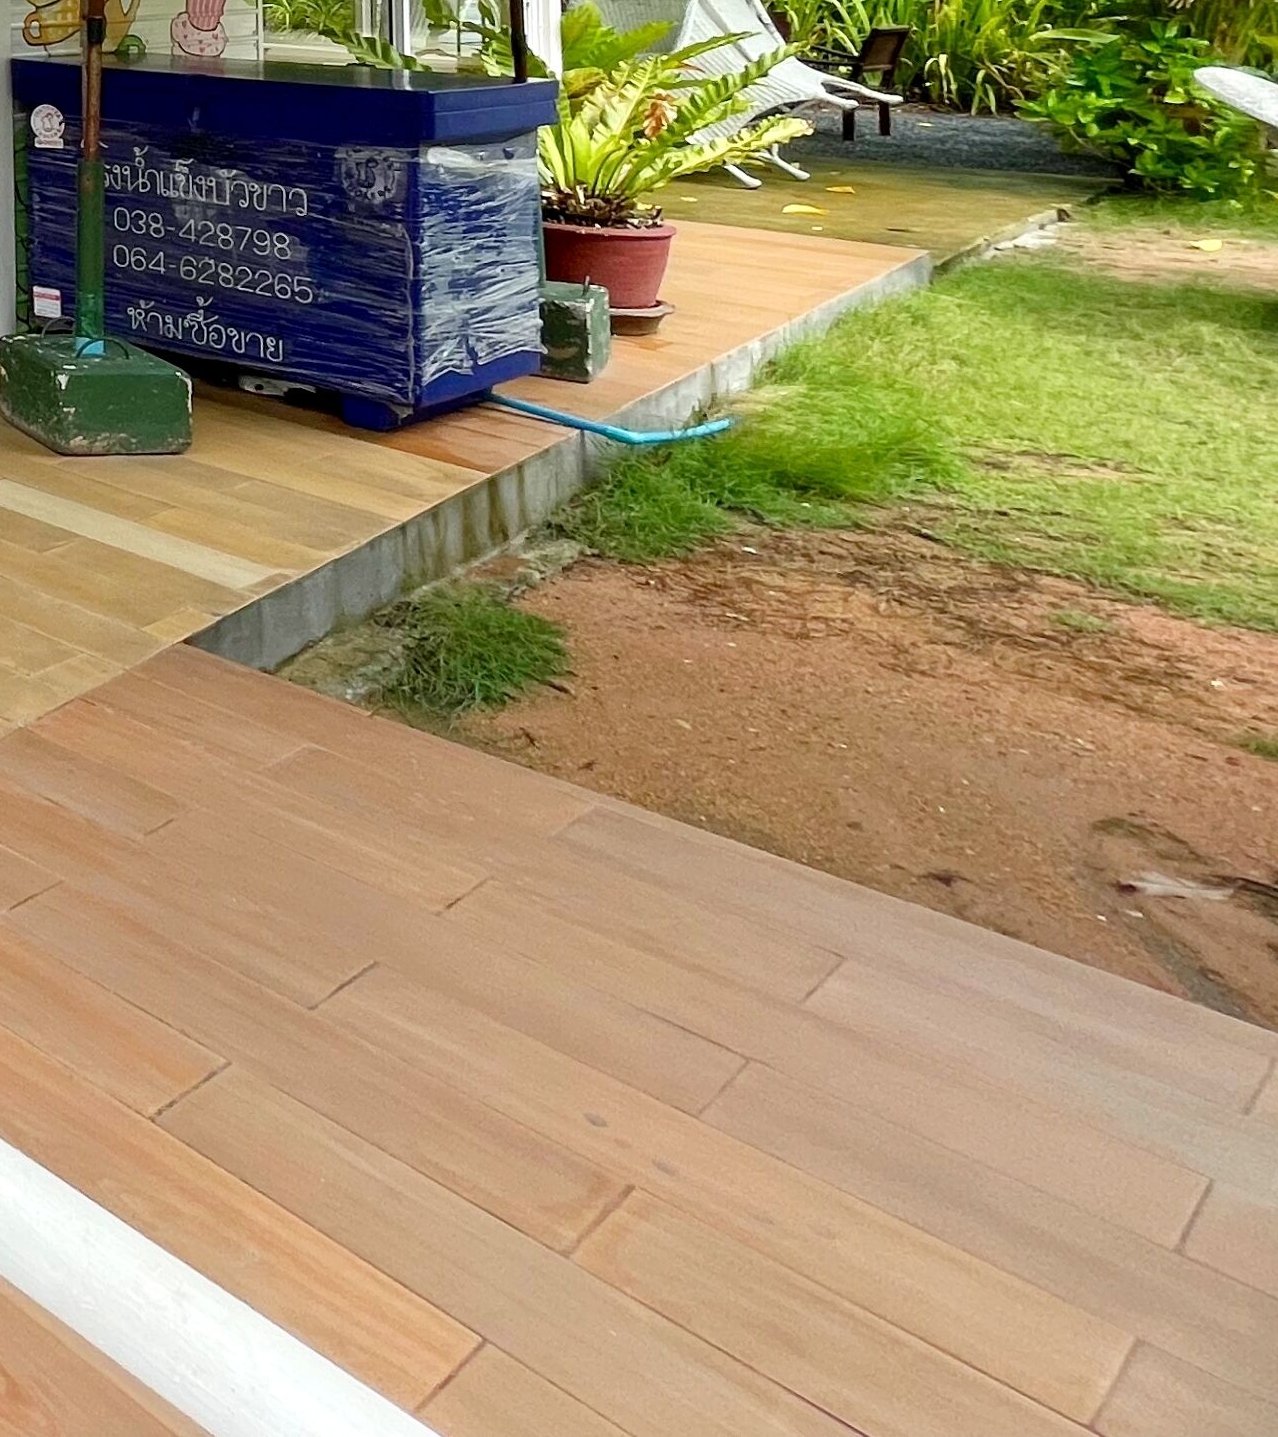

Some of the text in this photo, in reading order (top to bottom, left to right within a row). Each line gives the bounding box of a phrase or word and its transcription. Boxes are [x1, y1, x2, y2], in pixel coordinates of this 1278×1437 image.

[100, 139, 308, 217] งน้ำแข็งบัวขาว
[114, 207, 292, 260] 038-428798
[113, 244, 314, 304] 064-6282265
[127, 296, 284, 362] ห้ามซื้อขาย
